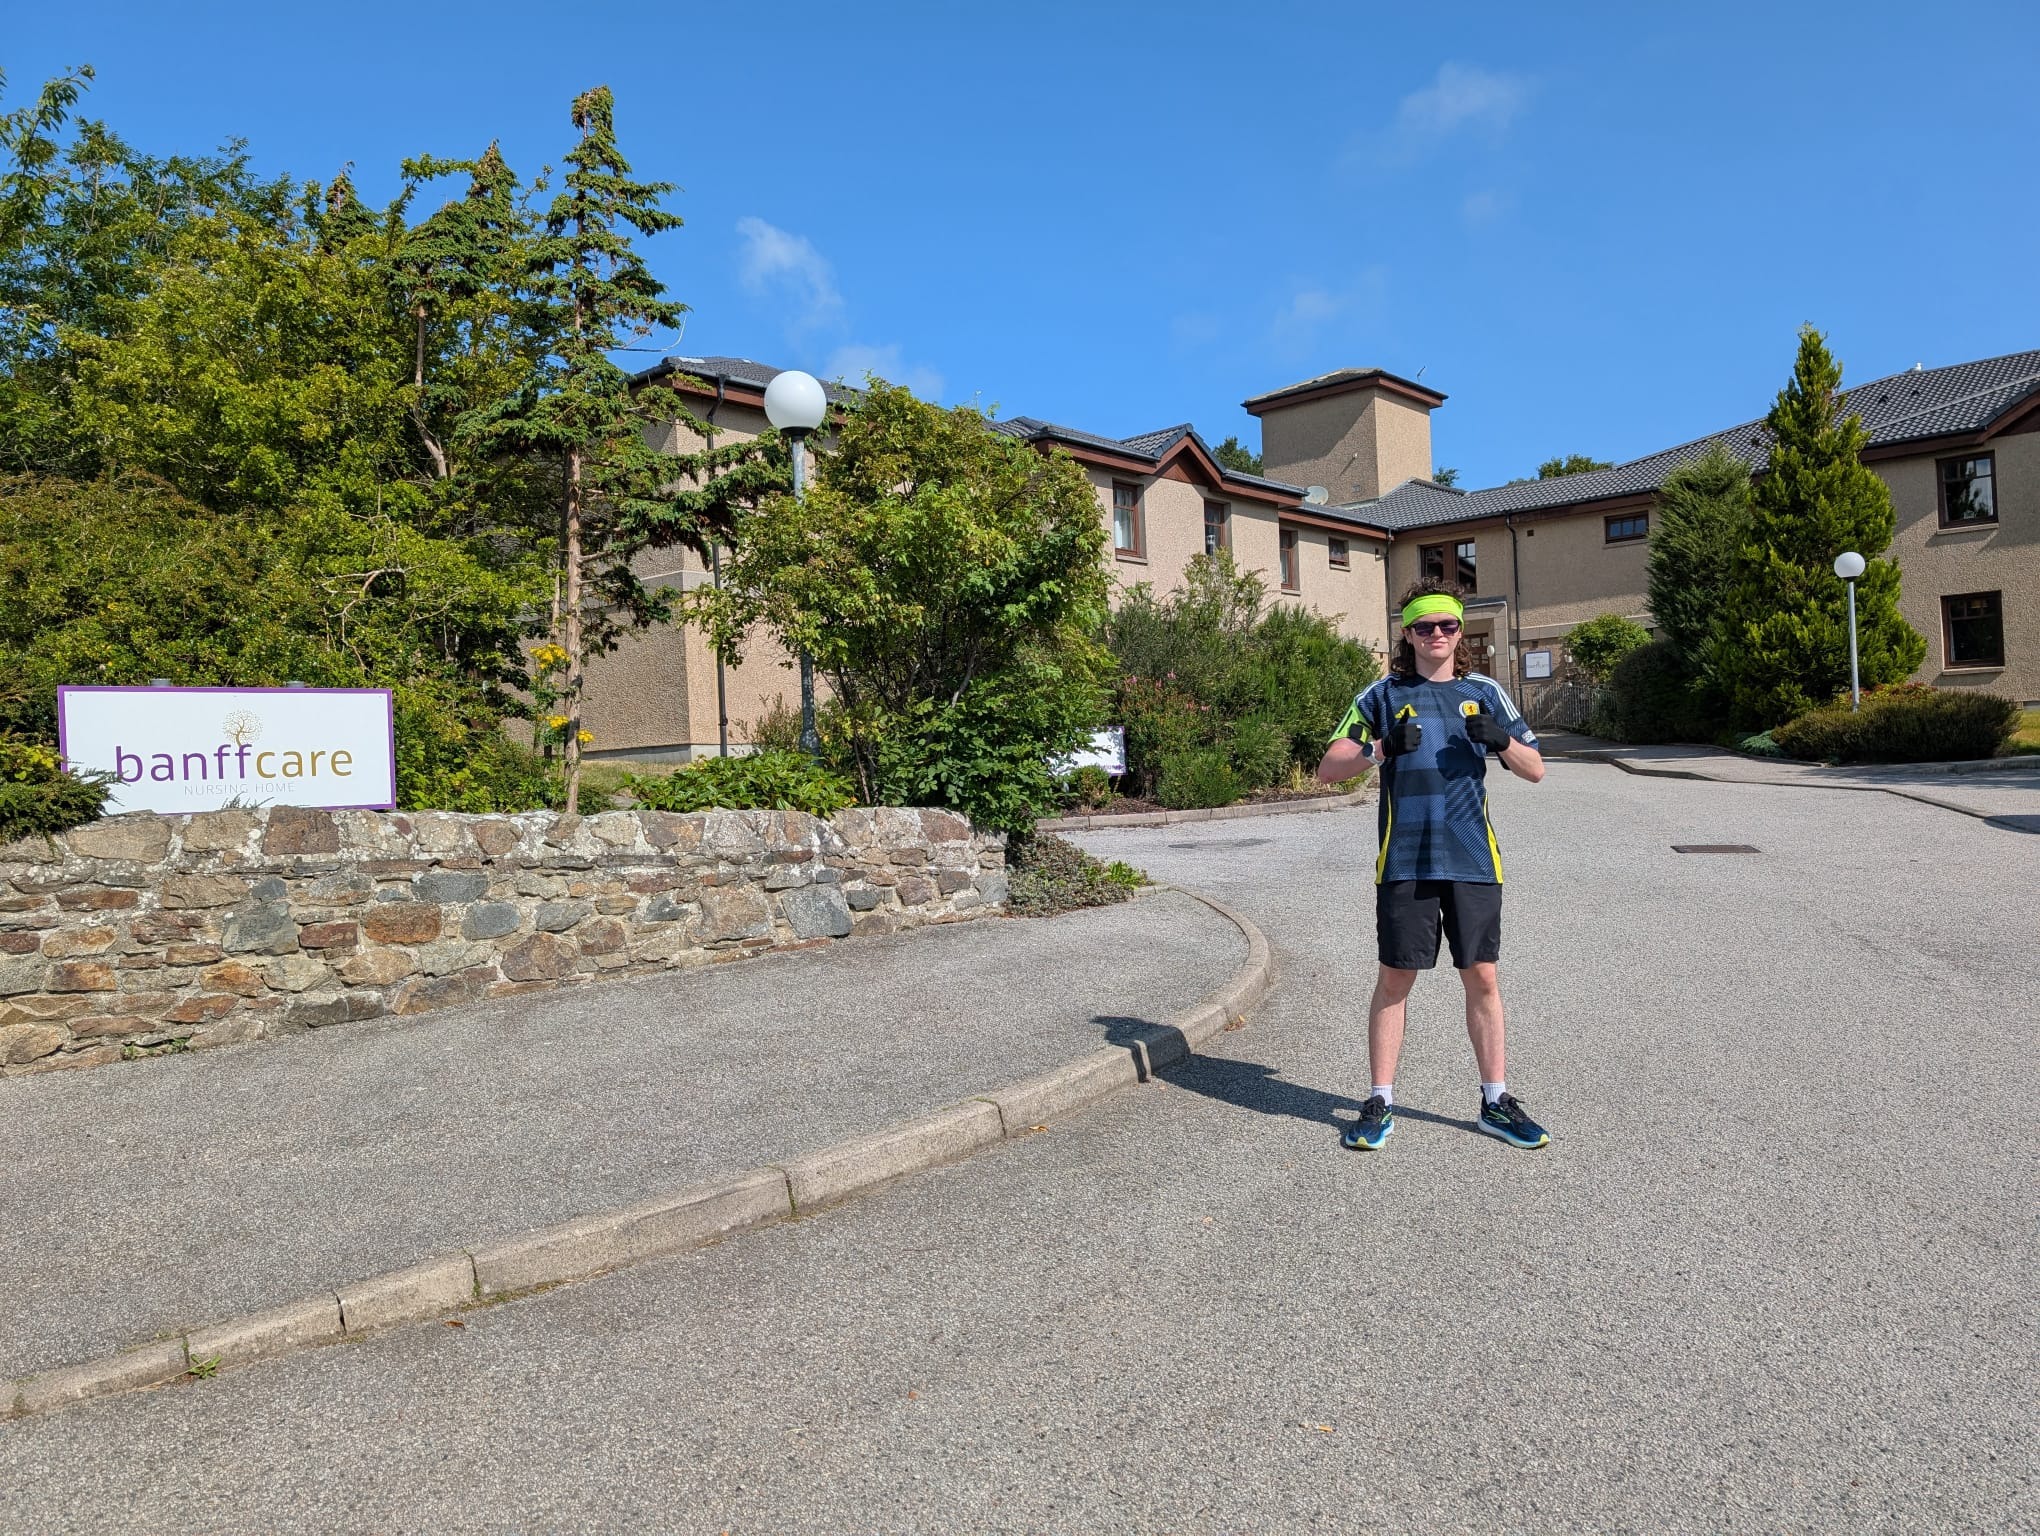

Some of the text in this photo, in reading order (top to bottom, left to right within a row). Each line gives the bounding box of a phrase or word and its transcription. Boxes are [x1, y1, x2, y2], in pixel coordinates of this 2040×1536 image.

[115, 744, 353, 783] banffcare
[184, 782, 296, 796] NURSING HOME
